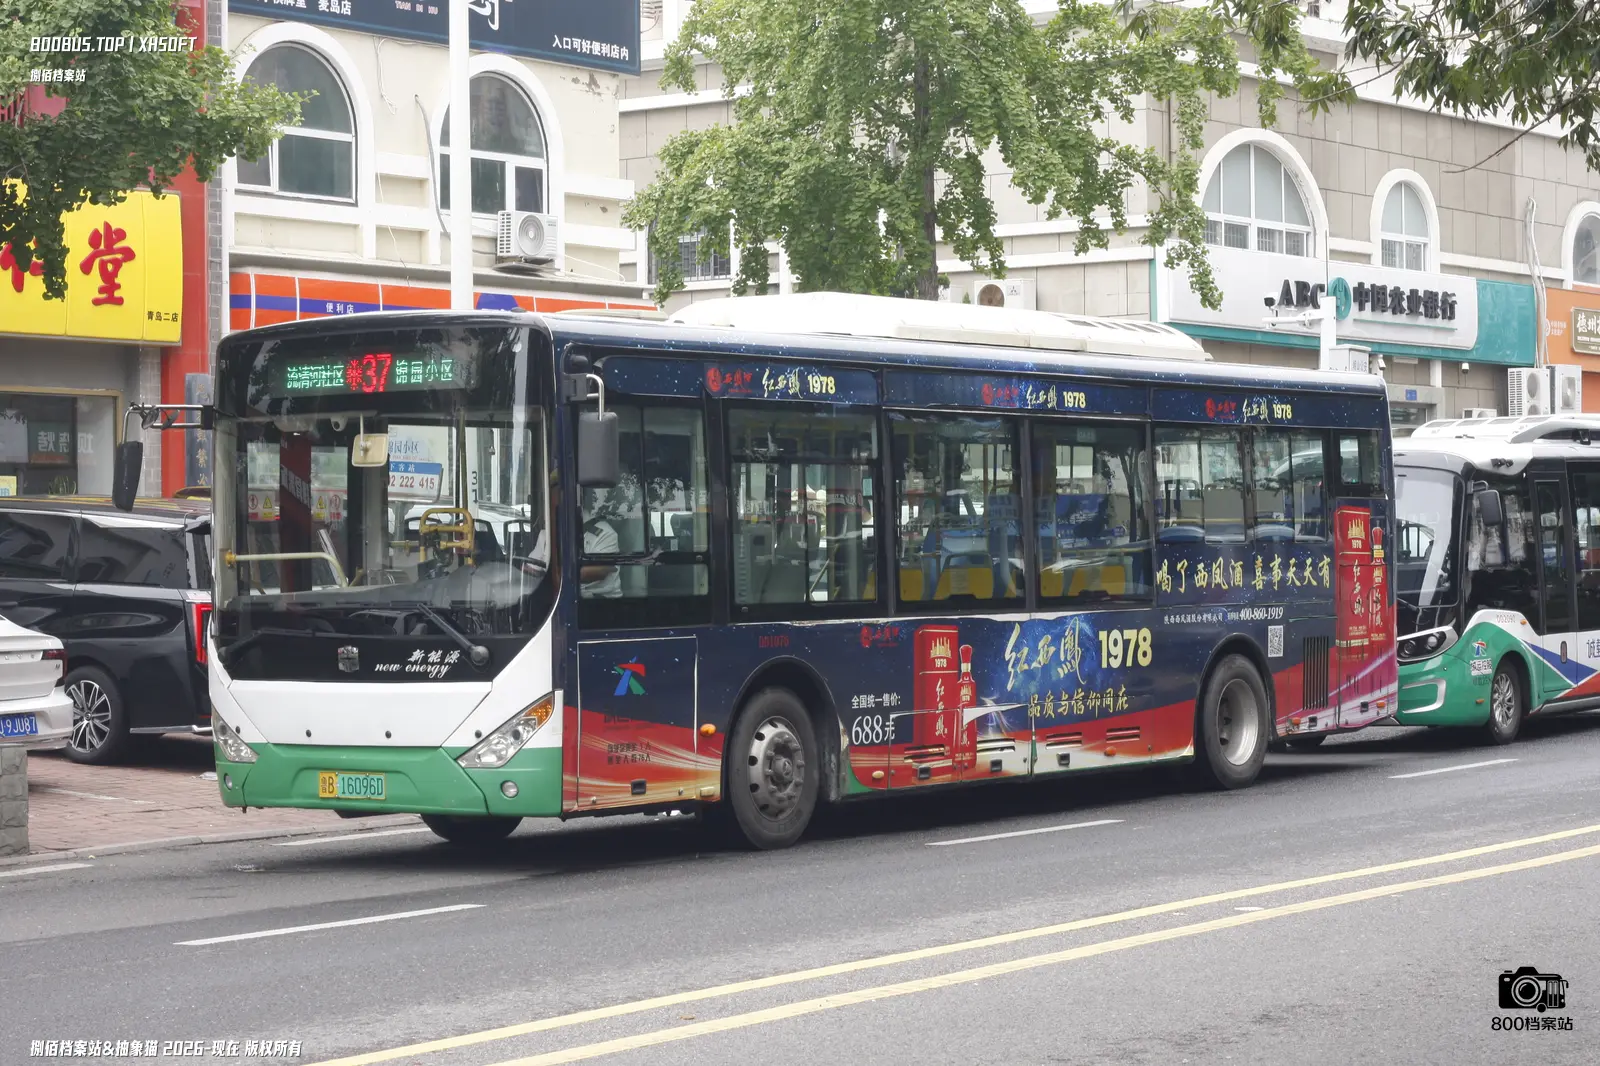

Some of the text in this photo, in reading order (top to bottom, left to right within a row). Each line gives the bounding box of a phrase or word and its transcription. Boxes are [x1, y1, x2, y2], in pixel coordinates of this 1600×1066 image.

[552, 34, 629, 61] 入口可好便利店内
[1277, 278, 1326, 309] ABC
[1352, 281, 1458, 321] 中国农业银行
[147, 310, 179, 322] 青岛二店
[325, 302, 354, 314] 便利店
[361, 352, 393, 393] 37
[808, 375, 836, 394] 1978
[1063, 391, 1086, 408] 1978
[1273, 403, 1292, 419] 1978
[399, 476, 415, 488] 222
[419, 477, 435, 490] 415
[1156, 553, 1332, 594] 喝了西凤酒 喜事天天有
[1239, 606, 1284, 621] 400-860-1919
[407, 648, 461, 663] 新能源
[1098, 627, 1153, 669] 1978
[374, 662, 451, 679] new energy
[934, 658, 948, 668] 1978
[1027, 683, 1129, 718] 品质与信仰同在
[851, 714, 896, 745] 688元
